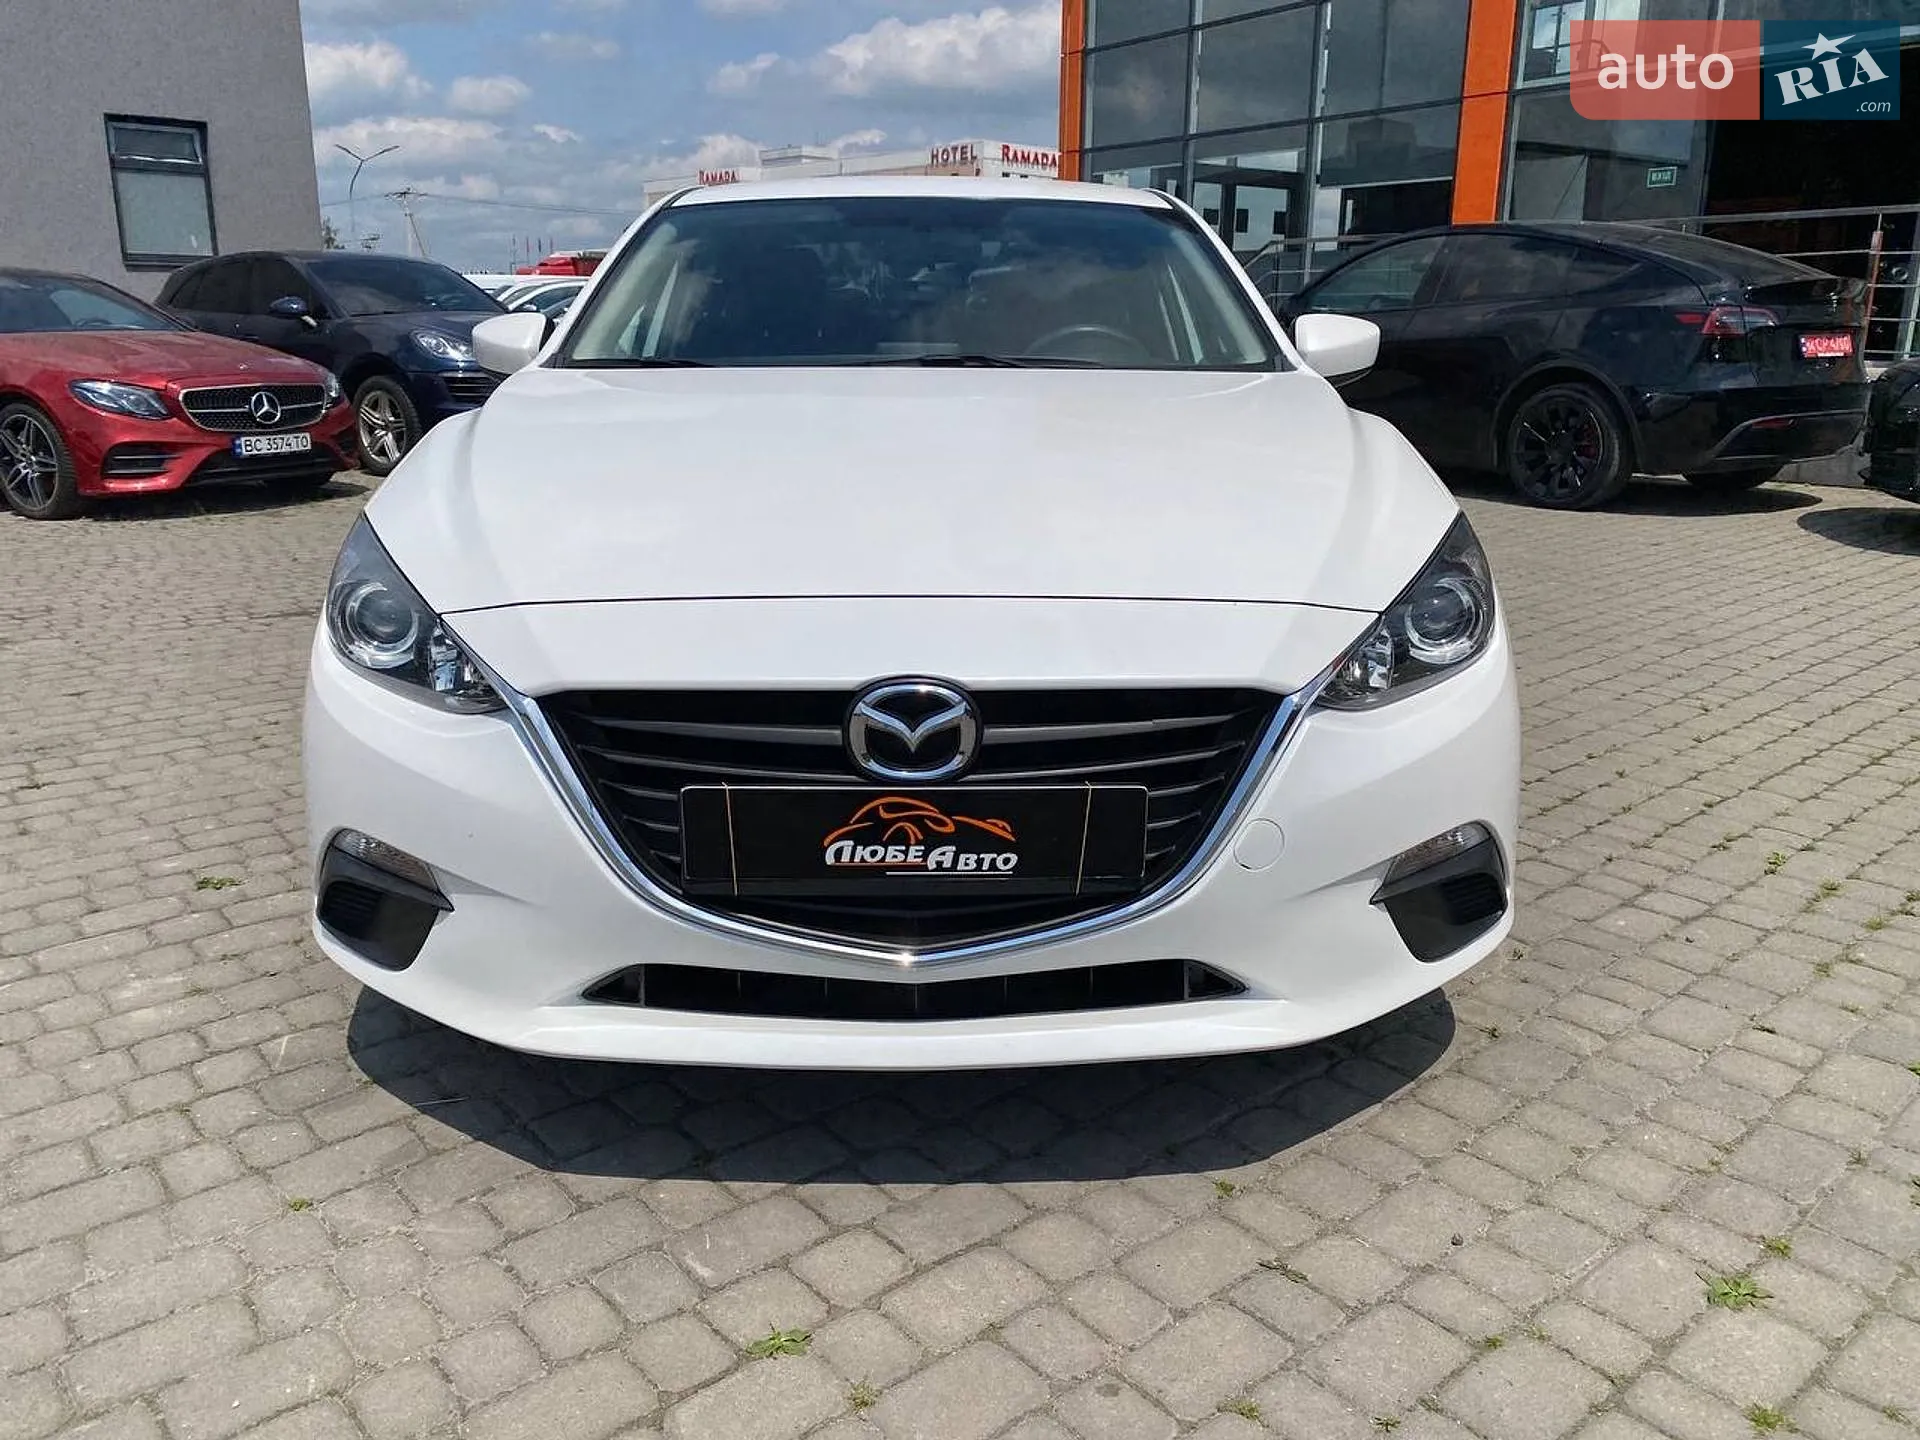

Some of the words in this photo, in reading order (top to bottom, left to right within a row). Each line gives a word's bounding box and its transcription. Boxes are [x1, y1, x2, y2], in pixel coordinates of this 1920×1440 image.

[931, 144, 978, 165] HOTEL
[1001, 144, 1058, 168] RAMADA
[244, 439, 263, 453] BC
